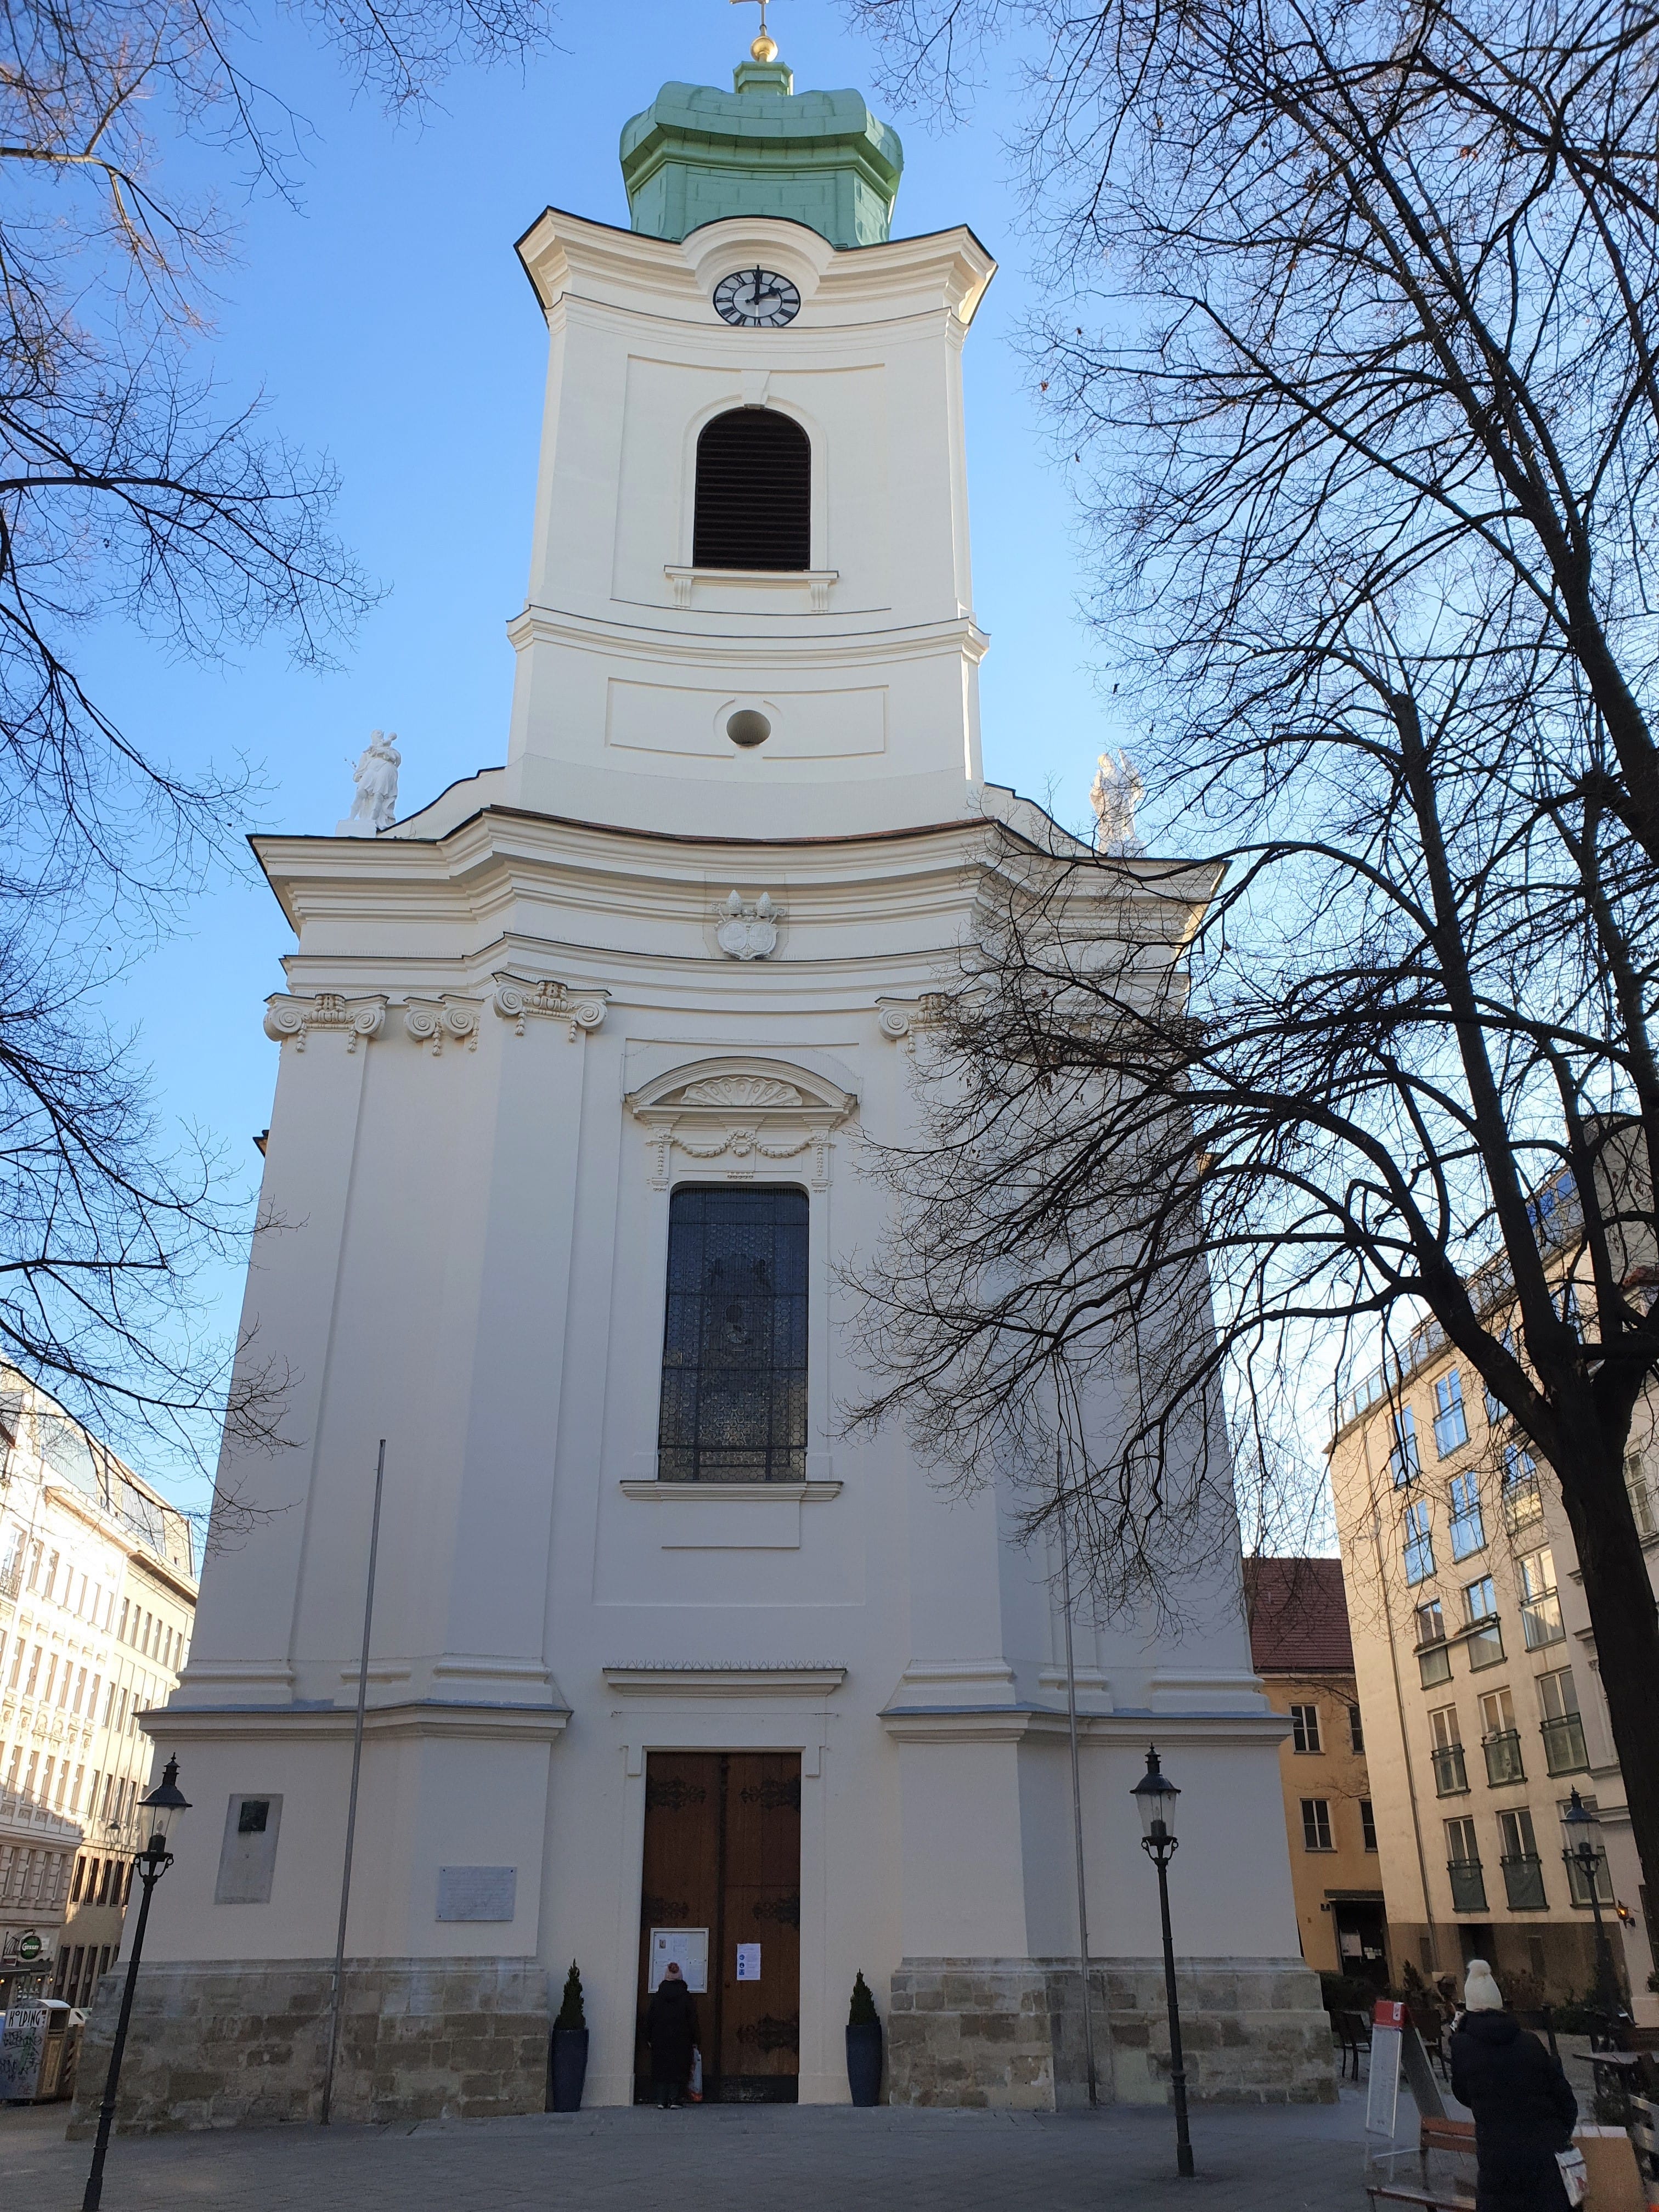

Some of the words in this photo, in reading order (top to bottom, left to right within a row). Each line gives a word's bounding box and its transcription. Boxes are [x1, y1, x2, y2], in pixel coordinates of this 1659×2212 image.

[732, 274, 746, 286] XI
[770, 275, 778, 285] I
[721, 284, 736, 292] X
